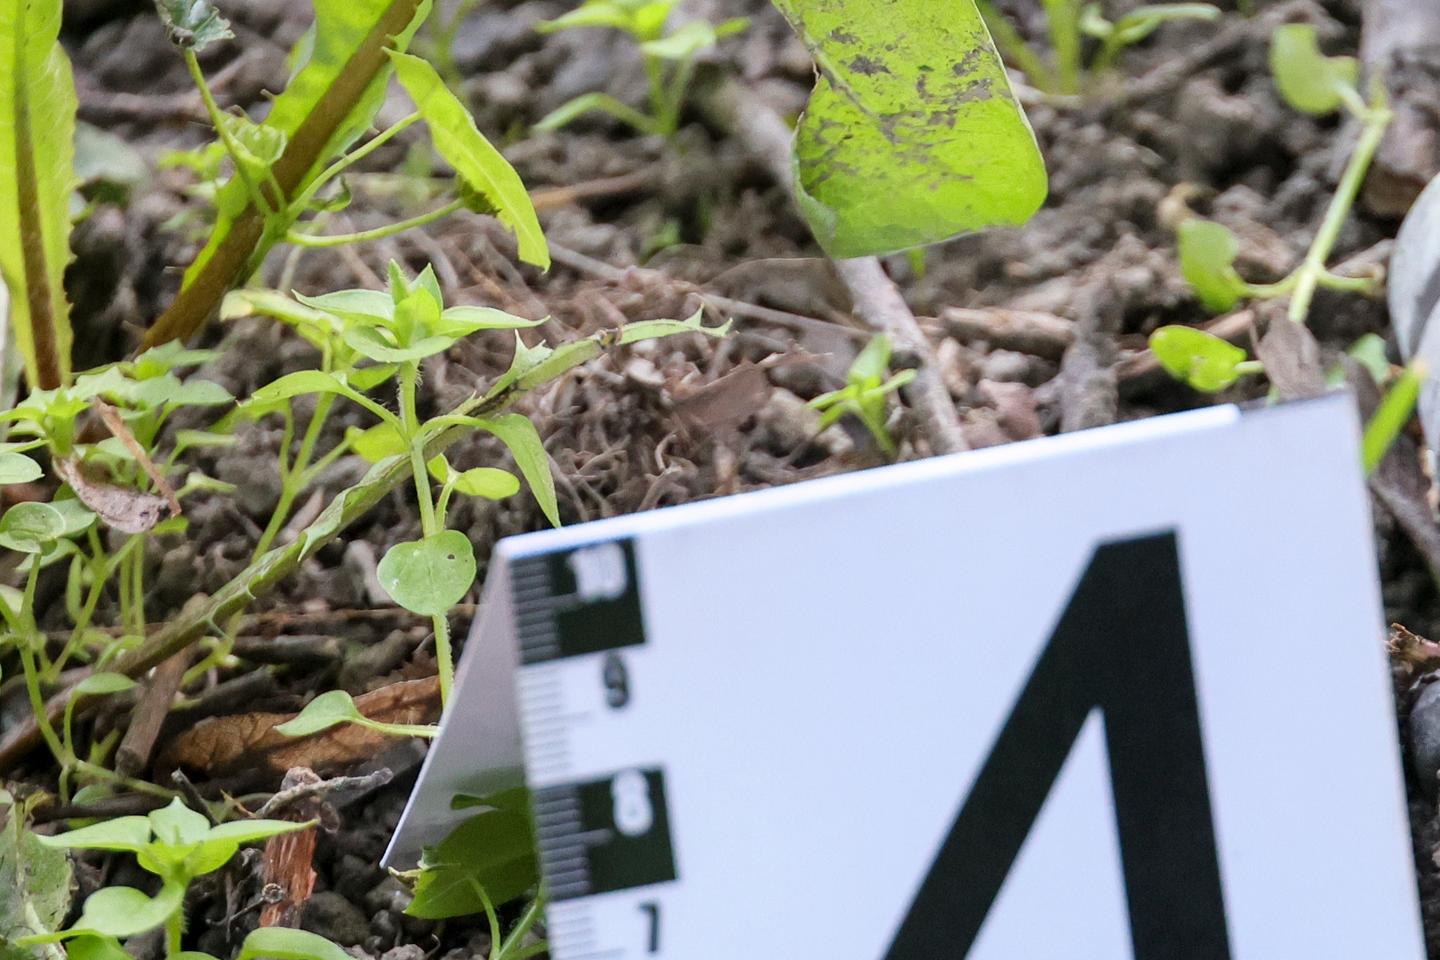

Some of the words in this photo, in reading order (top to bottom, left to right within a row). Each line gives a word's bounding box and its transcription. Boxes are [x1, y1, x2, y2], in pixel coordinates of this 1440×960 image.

[602, 649, 632, 708] 9
[611, 768, 652, 837] 8
[637, 898, 661, 953] 7
